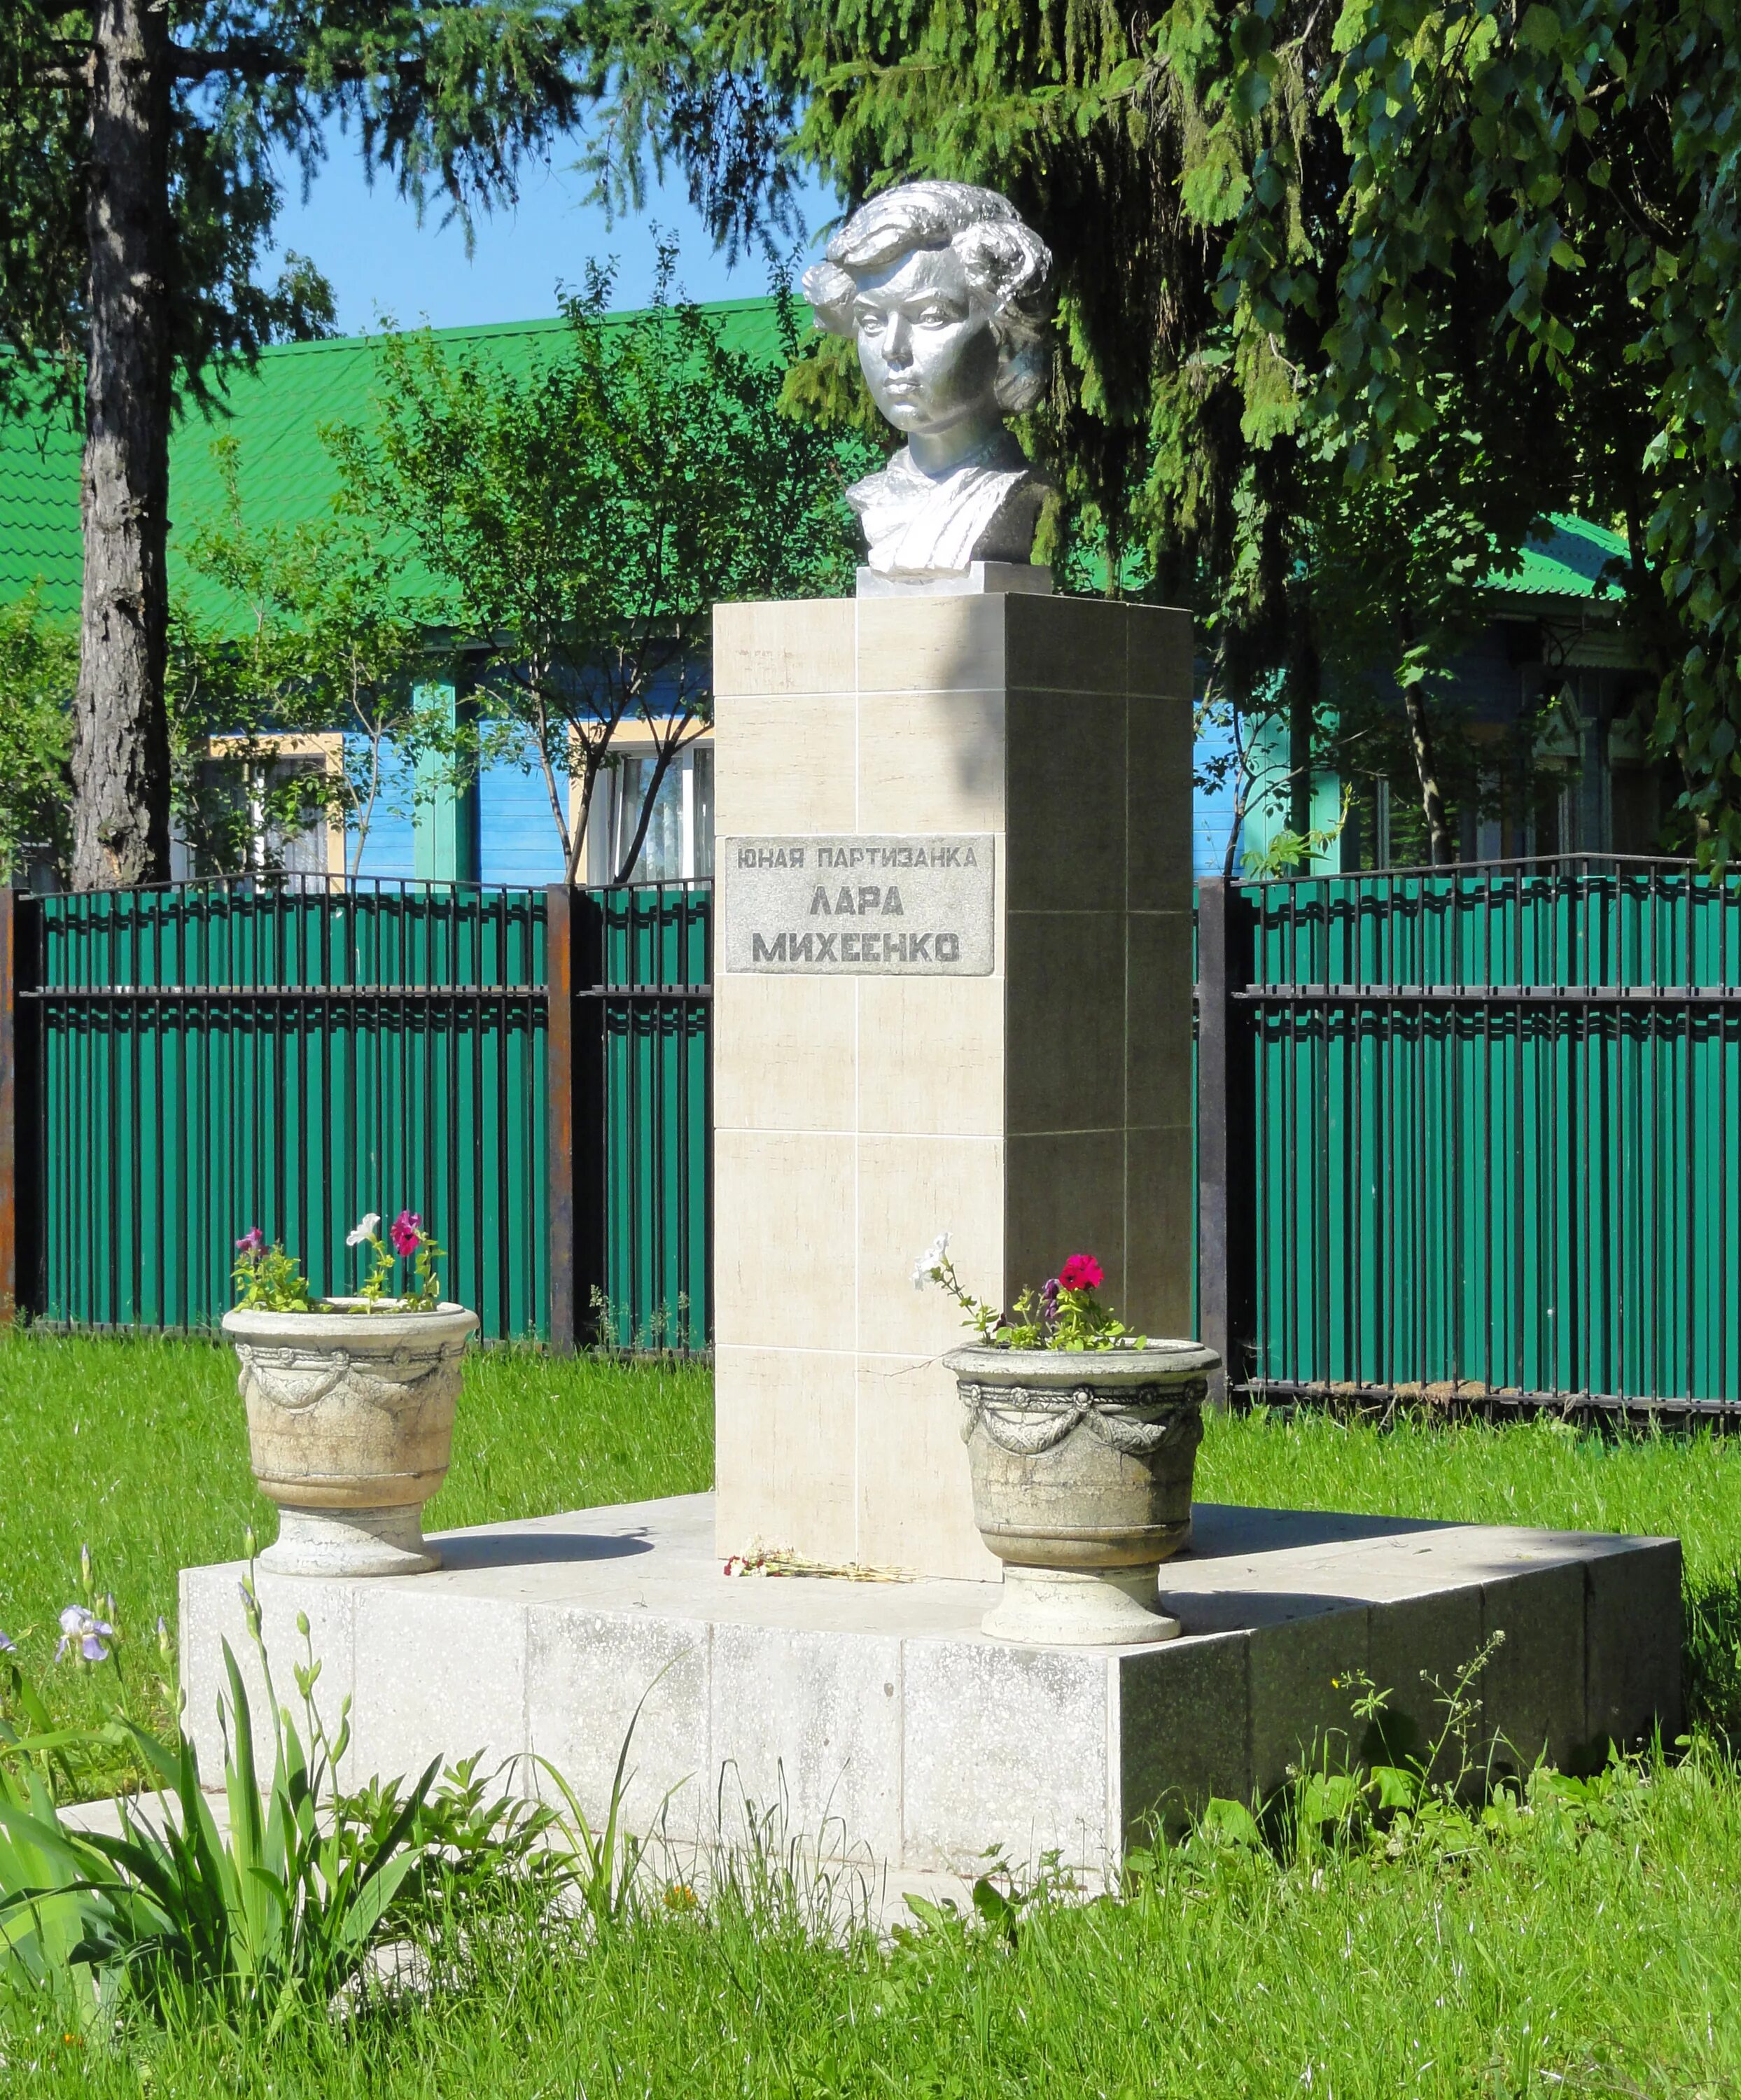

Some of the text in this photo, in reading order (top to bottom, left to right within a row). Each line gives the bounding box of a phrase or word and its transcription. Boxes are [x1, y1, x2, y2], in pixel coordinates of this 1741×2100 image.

[737, 846, 978, 868] ЮНАЯ ПАРТИЗАНКА
[809, 886, 904, 916] ЛАРА
[752, 932, 959, 962] МИХЕЕНКО
